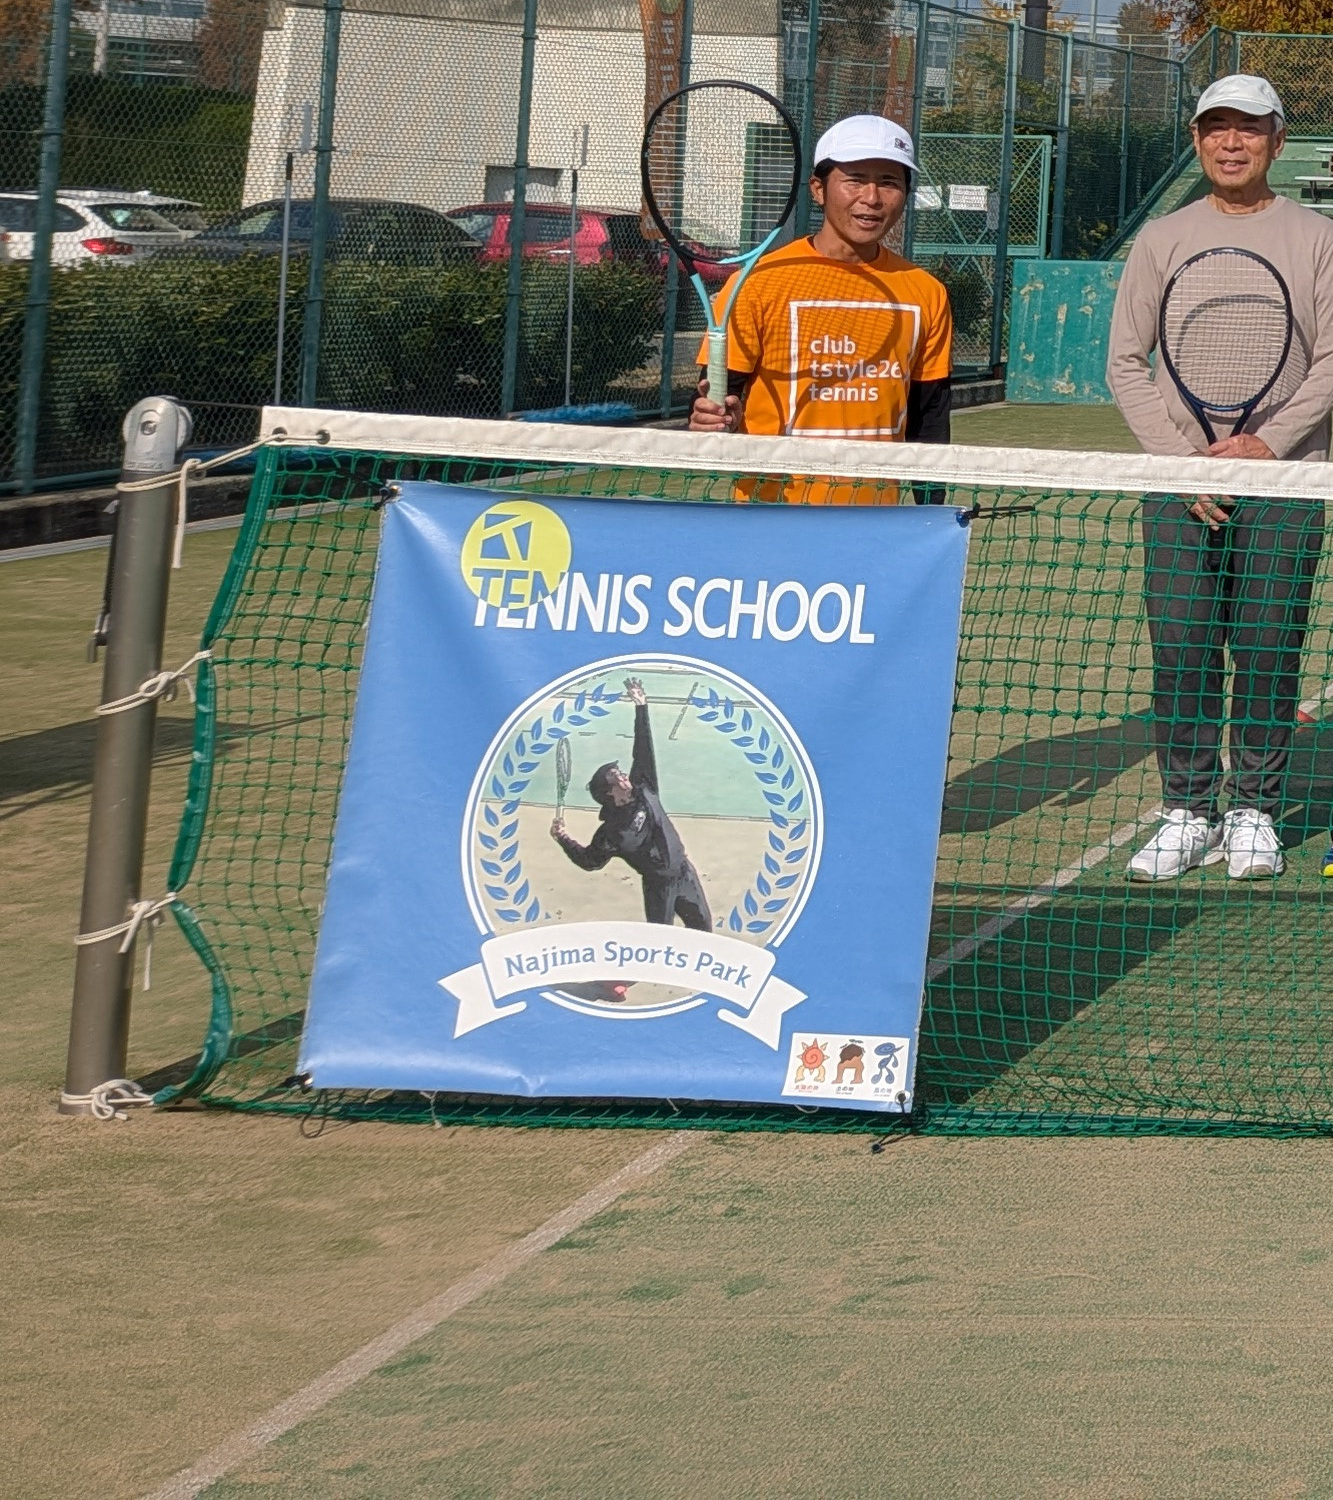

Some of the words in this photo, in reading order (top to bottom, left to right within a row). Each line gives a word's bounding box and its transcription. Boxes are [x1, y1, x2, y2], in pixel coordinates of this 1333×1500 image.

[810, 335, 856, 354] club
[809, 359, 903, 382] tstyle26
[809, 382, 879, 401] tennis
[472, 567, 652, 635] TENNIS
[663, 576, 875, 644] SCHOOL
[504, 946, 596, 978] Najima
[604, 941, 689, 968] Sports
[694, 952, 752, 989] Park
